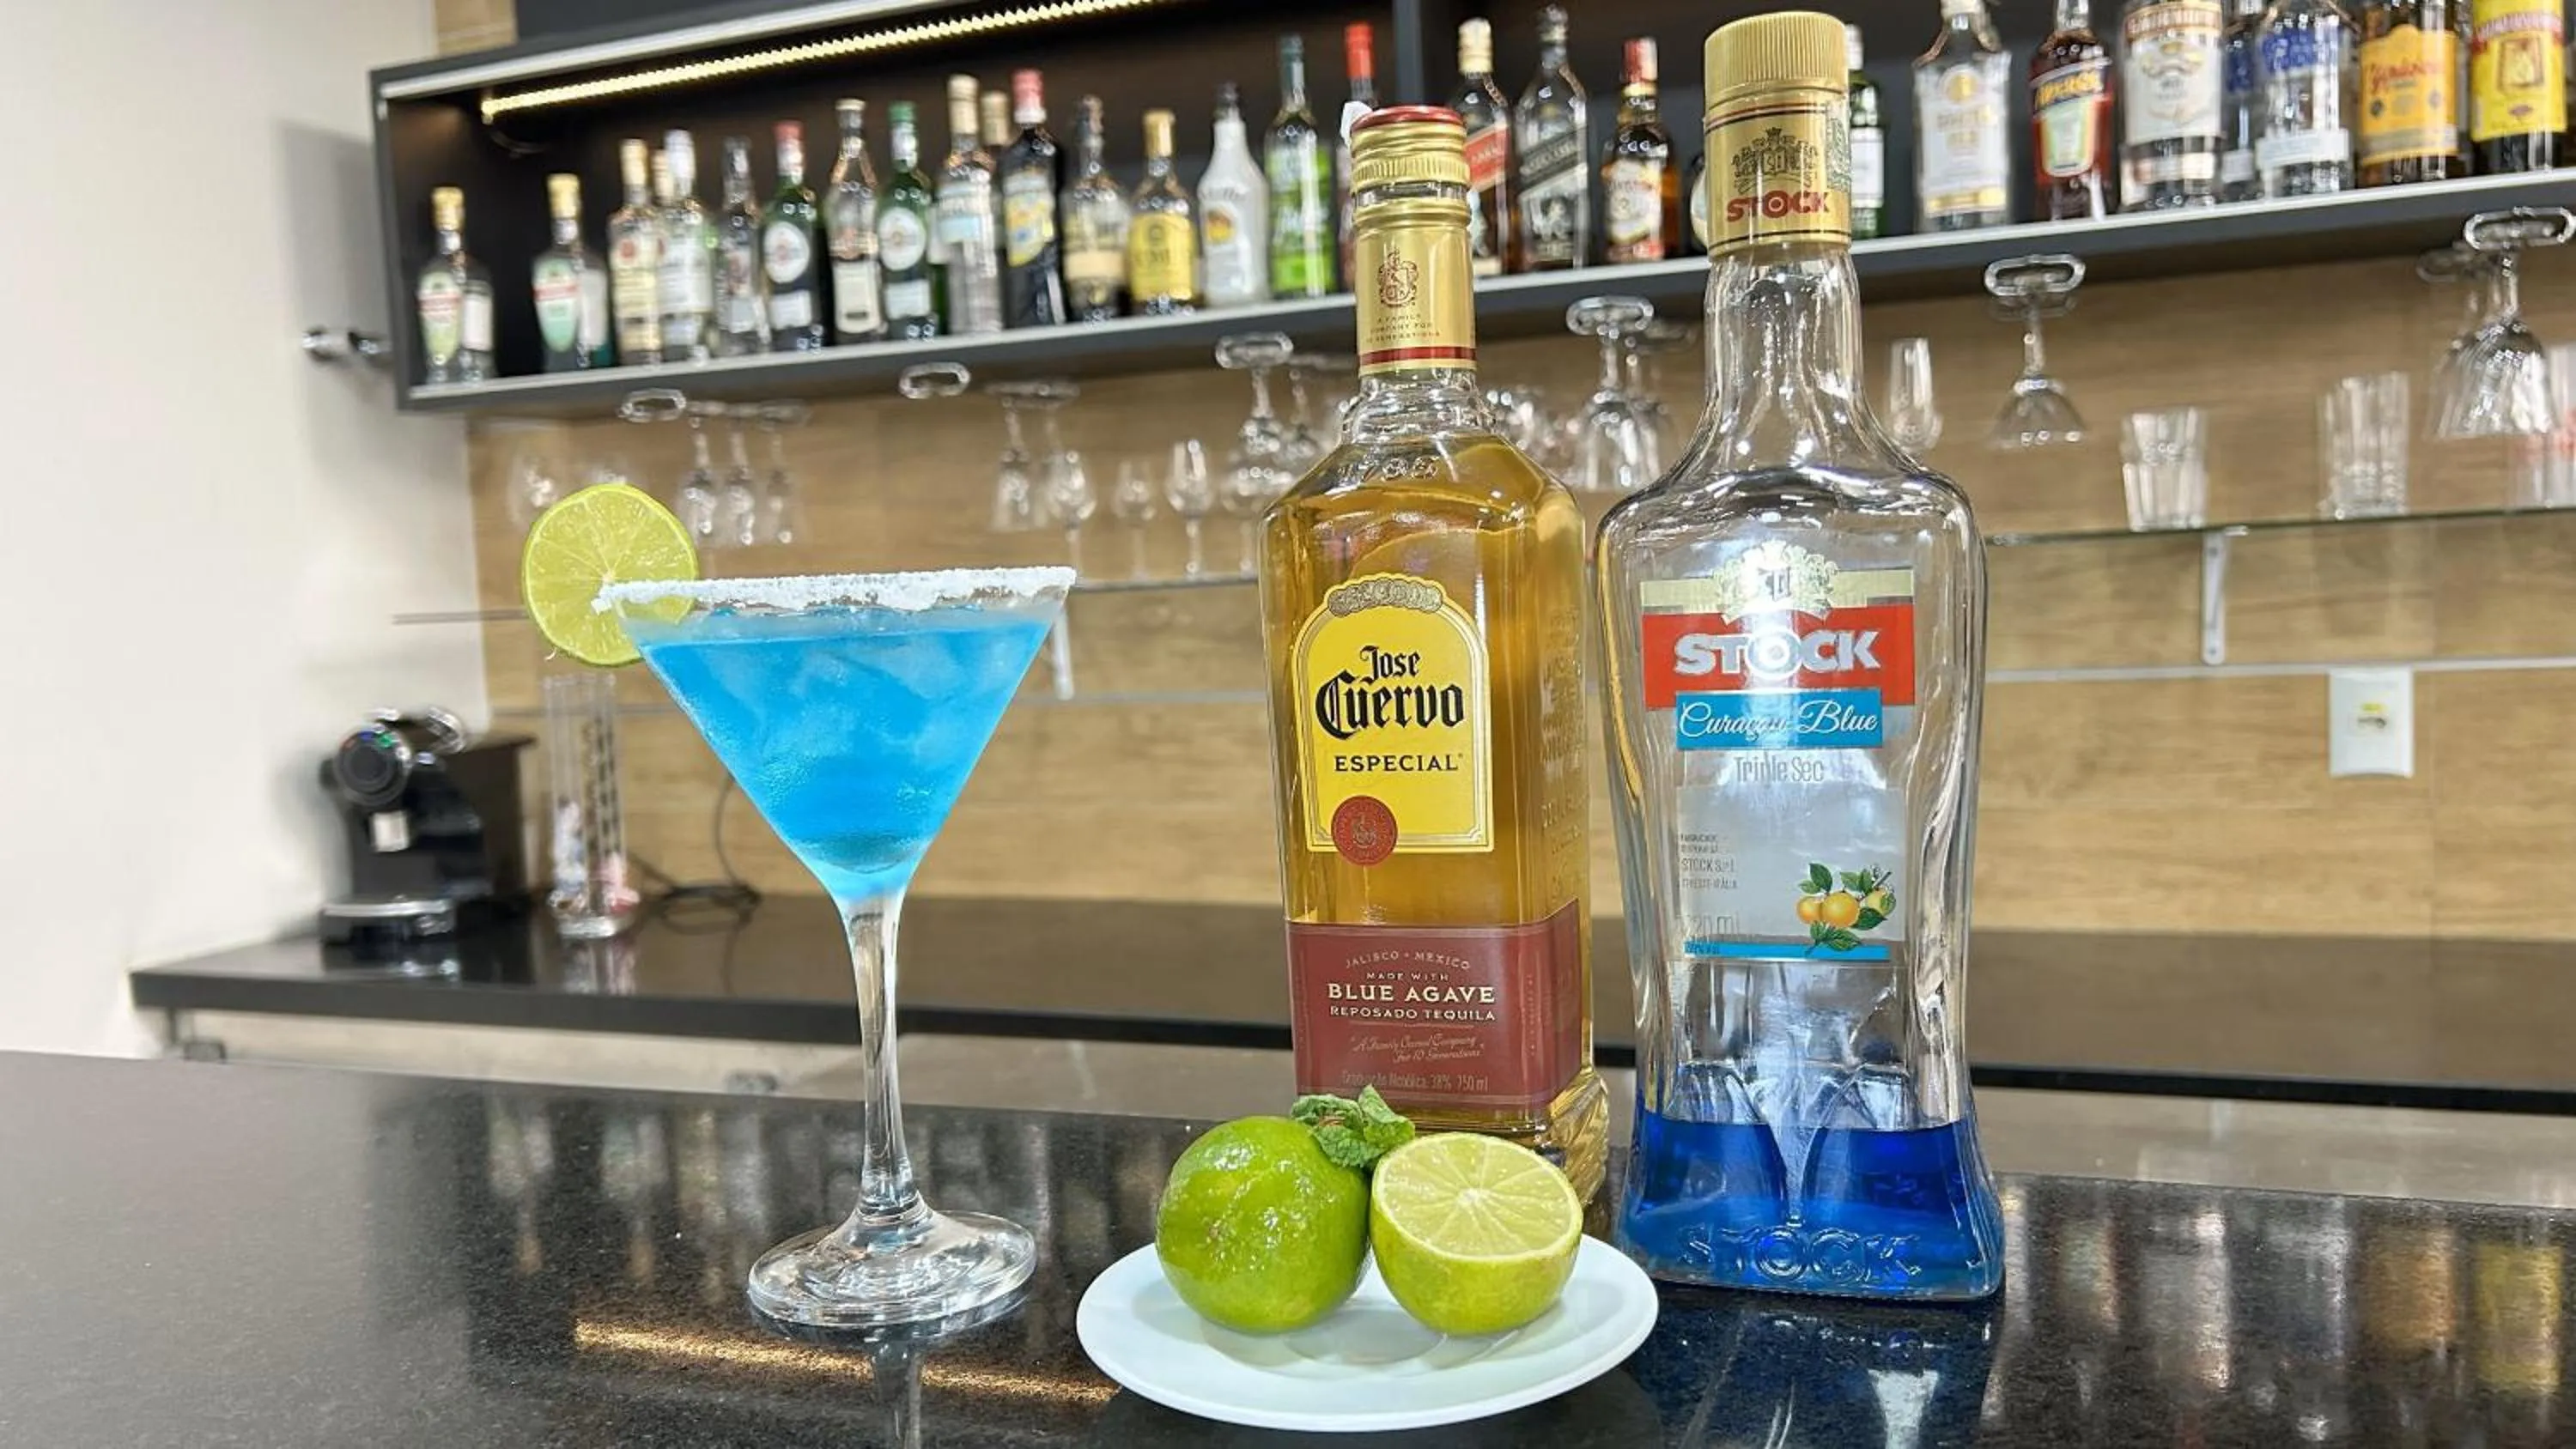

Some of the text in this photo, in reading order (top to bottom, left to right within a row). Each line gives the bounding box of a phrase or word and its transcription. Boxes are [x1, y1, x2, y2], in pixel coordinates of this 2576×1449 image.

[1727, 190, 1830, 222] STOCK
[1360, 645, 1420, 685] Jose
[1674, 629, 1880, 681] STOCK
[1315, 670, 1464, 740] Cuervo
[1798, 700, 1878, 734] Blue
[1334, 755, 1459, 772] ESPECIAL
[1791, 755, 1824, 782] Sec
[1346, 950, 1471, 970] JALISCO MEXICO
[1327, 983, 1495, 1003] BLUE AGAVE
[1330, 1005, 1496, 1022] REPOSADO TEQUILA
[1677, 1224, 1922, 1282] STOCK
